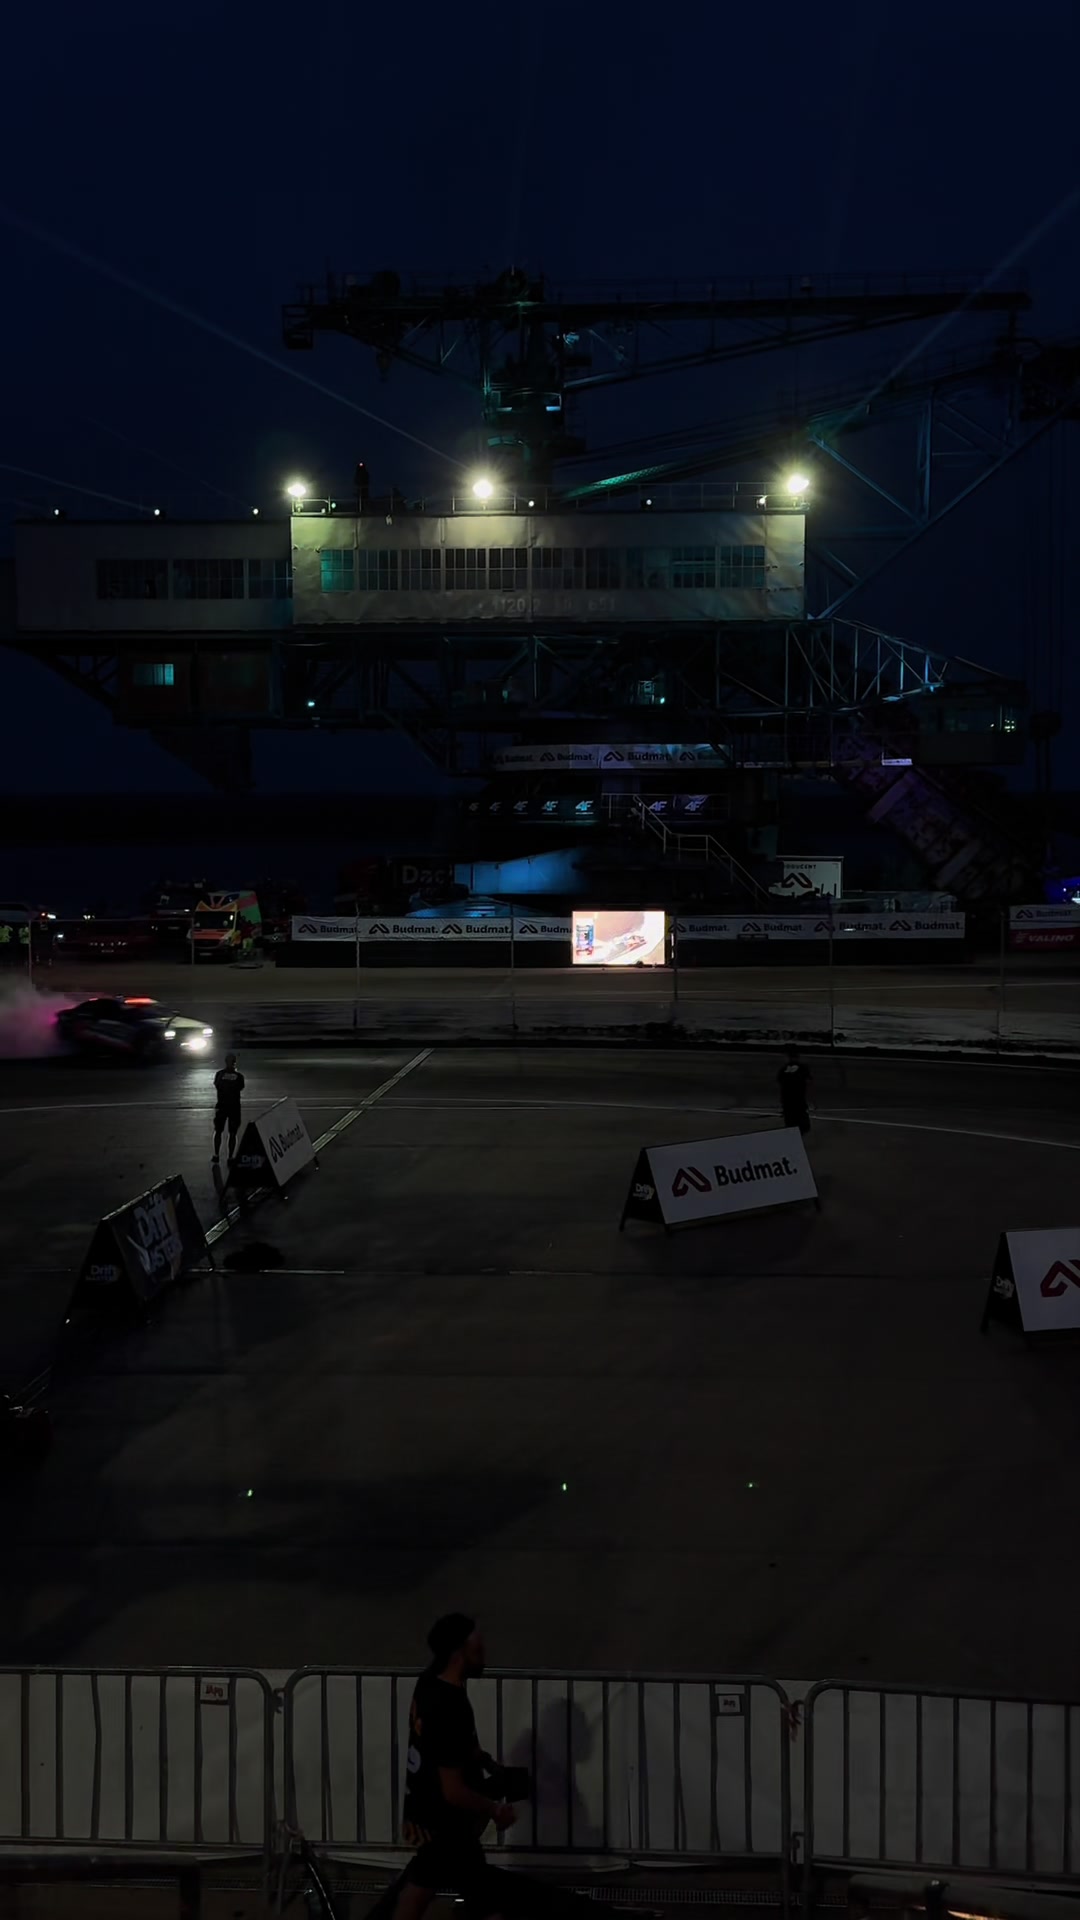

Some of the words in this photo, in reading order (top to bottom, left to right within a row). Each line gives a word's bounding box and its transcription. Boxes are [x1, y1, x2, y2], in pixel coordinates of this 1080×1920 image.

[513, 800, 528, 811] 4F
[541, 800, 559, 811] 4F
[575, 800, 594, 811] 4F
[650, 801, 668, 811] 4F
[684, 801, 702, 811] 4F
[393, 925, 438, 934] Budmat.
[466, 925, 512, 934] Budmat.
[689, 923, 730, 932] Budmat.
[763, 923, 806, 932] Budmat.
[915, 921, 963, 930] Budmat.
[1029, 934, 1075, 943] VALINO
[713, 1157, 798, 1186] Budmat.
